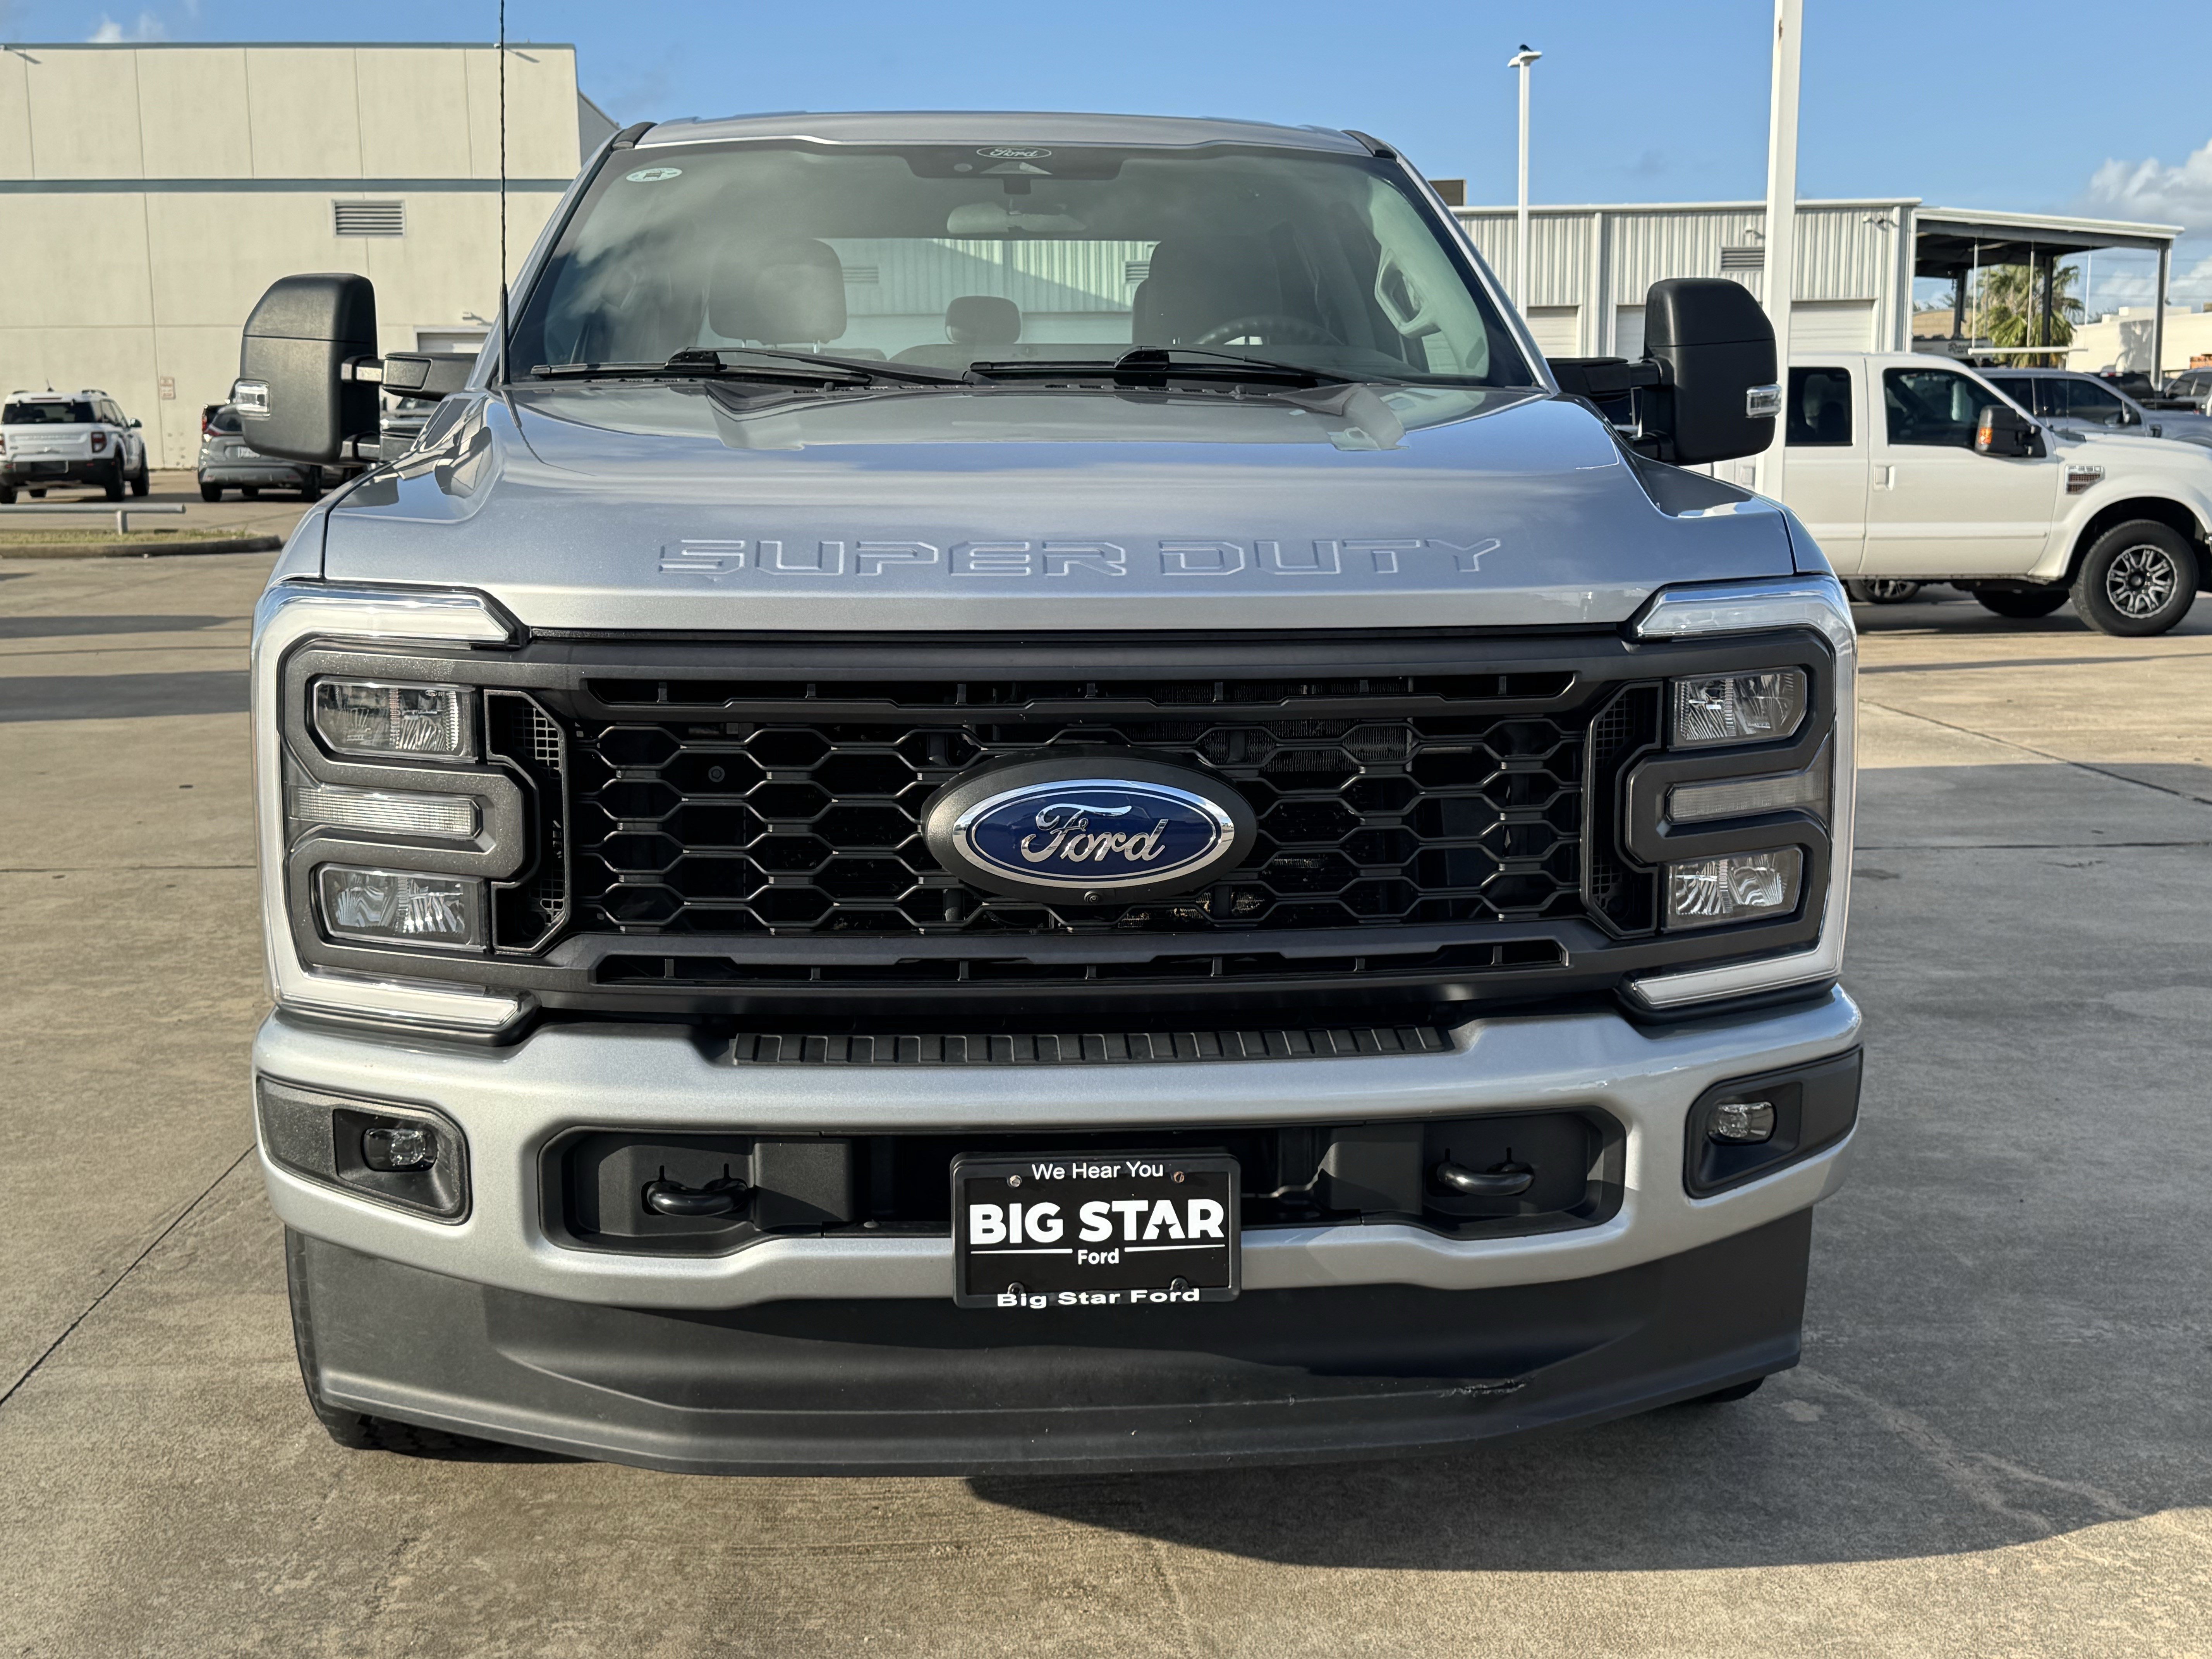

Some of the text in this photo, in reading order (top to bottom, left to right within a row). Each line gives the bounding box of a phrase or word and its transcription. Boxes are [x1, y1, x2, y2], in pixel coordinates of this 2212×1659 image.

[990, 148, 1038, 156] Ford
[658, 538, 1501, 576] SUPER DUTY
[1021, 803, 1170, 863] Ford
[1032, 1161, 1164, 1180] We Hear You
[970, 1199, 1224, 1245] BIG STAR
[1077, 1248, 1119, 1265] Ford
[997, 1288, 1200, 1309] Big Star Ford
